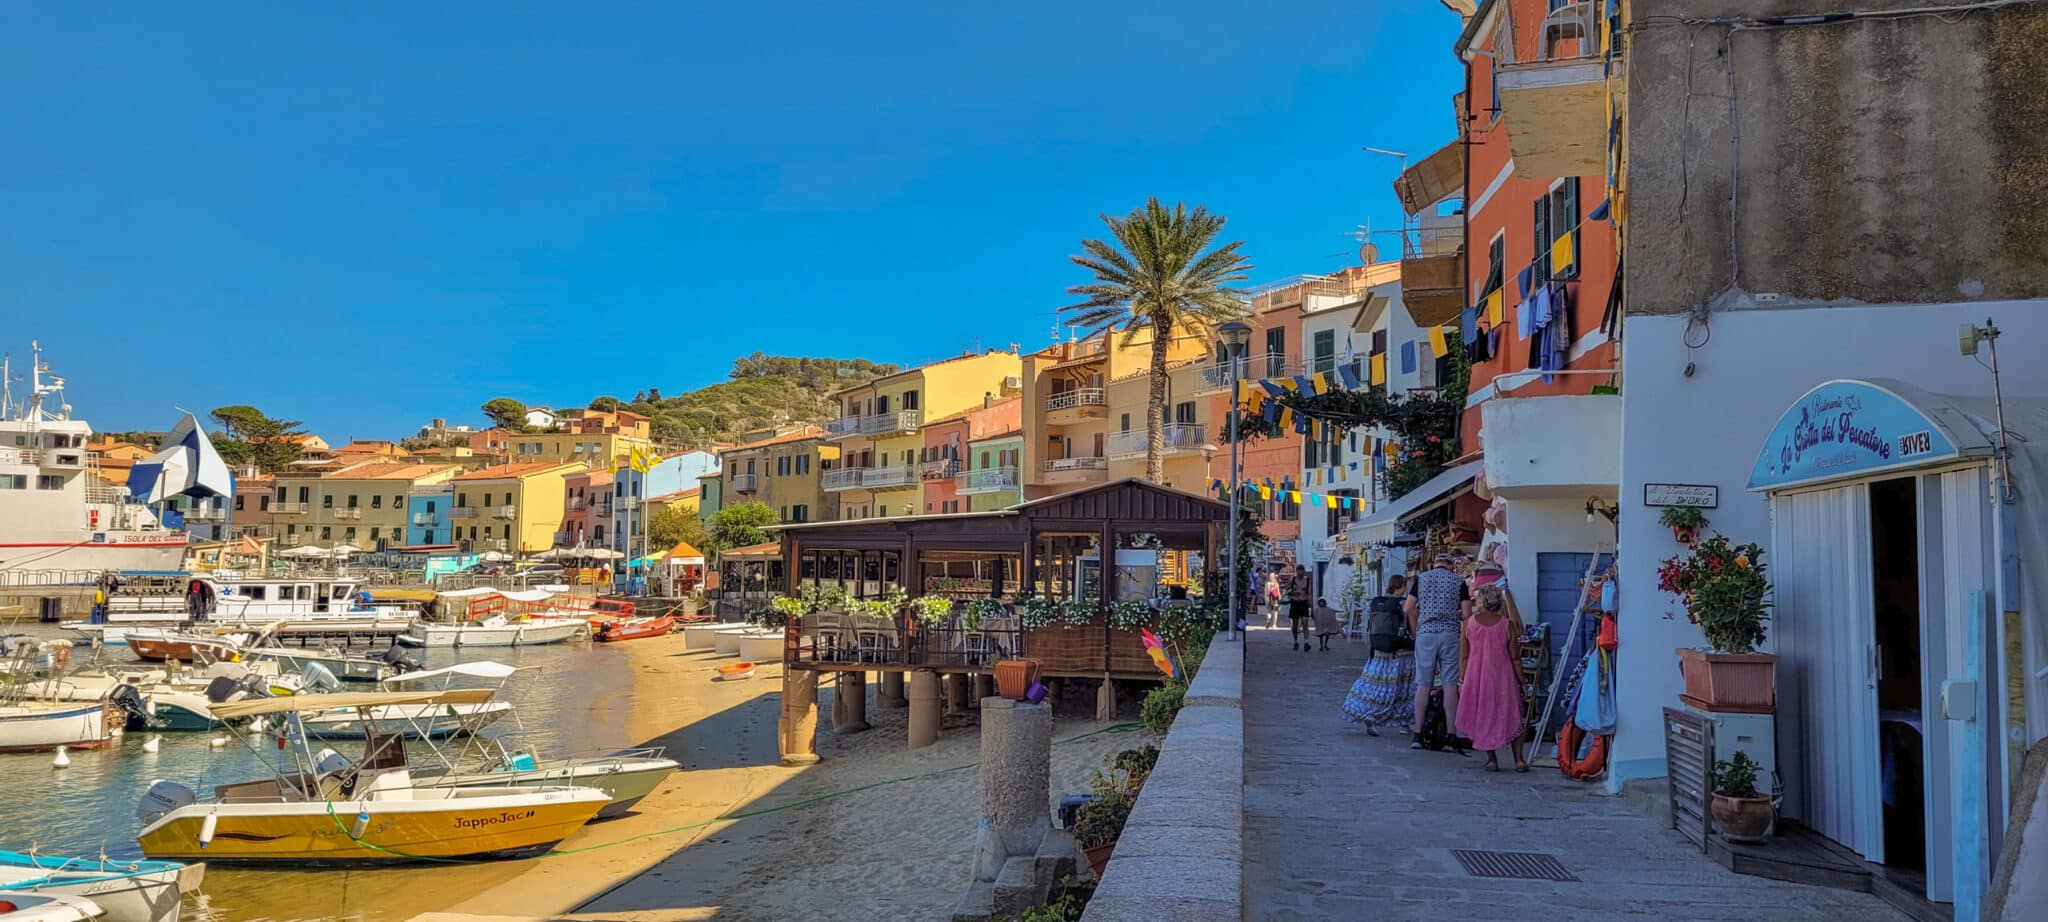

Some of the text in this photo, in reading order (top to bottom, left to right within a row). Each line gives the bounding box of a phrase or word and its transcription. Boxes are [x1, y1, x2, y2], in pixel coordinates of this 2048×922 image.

[1812, 394, 1842, 417] Ristorante
[1794, 421, 1818, 462] Grotta
[1821, 418, 1834, 443] del
[1838, 412, 1890, 459] Pescatore
[123, 535, 146, 543] ISOLA
[148, 535, 162, 543] DEL
